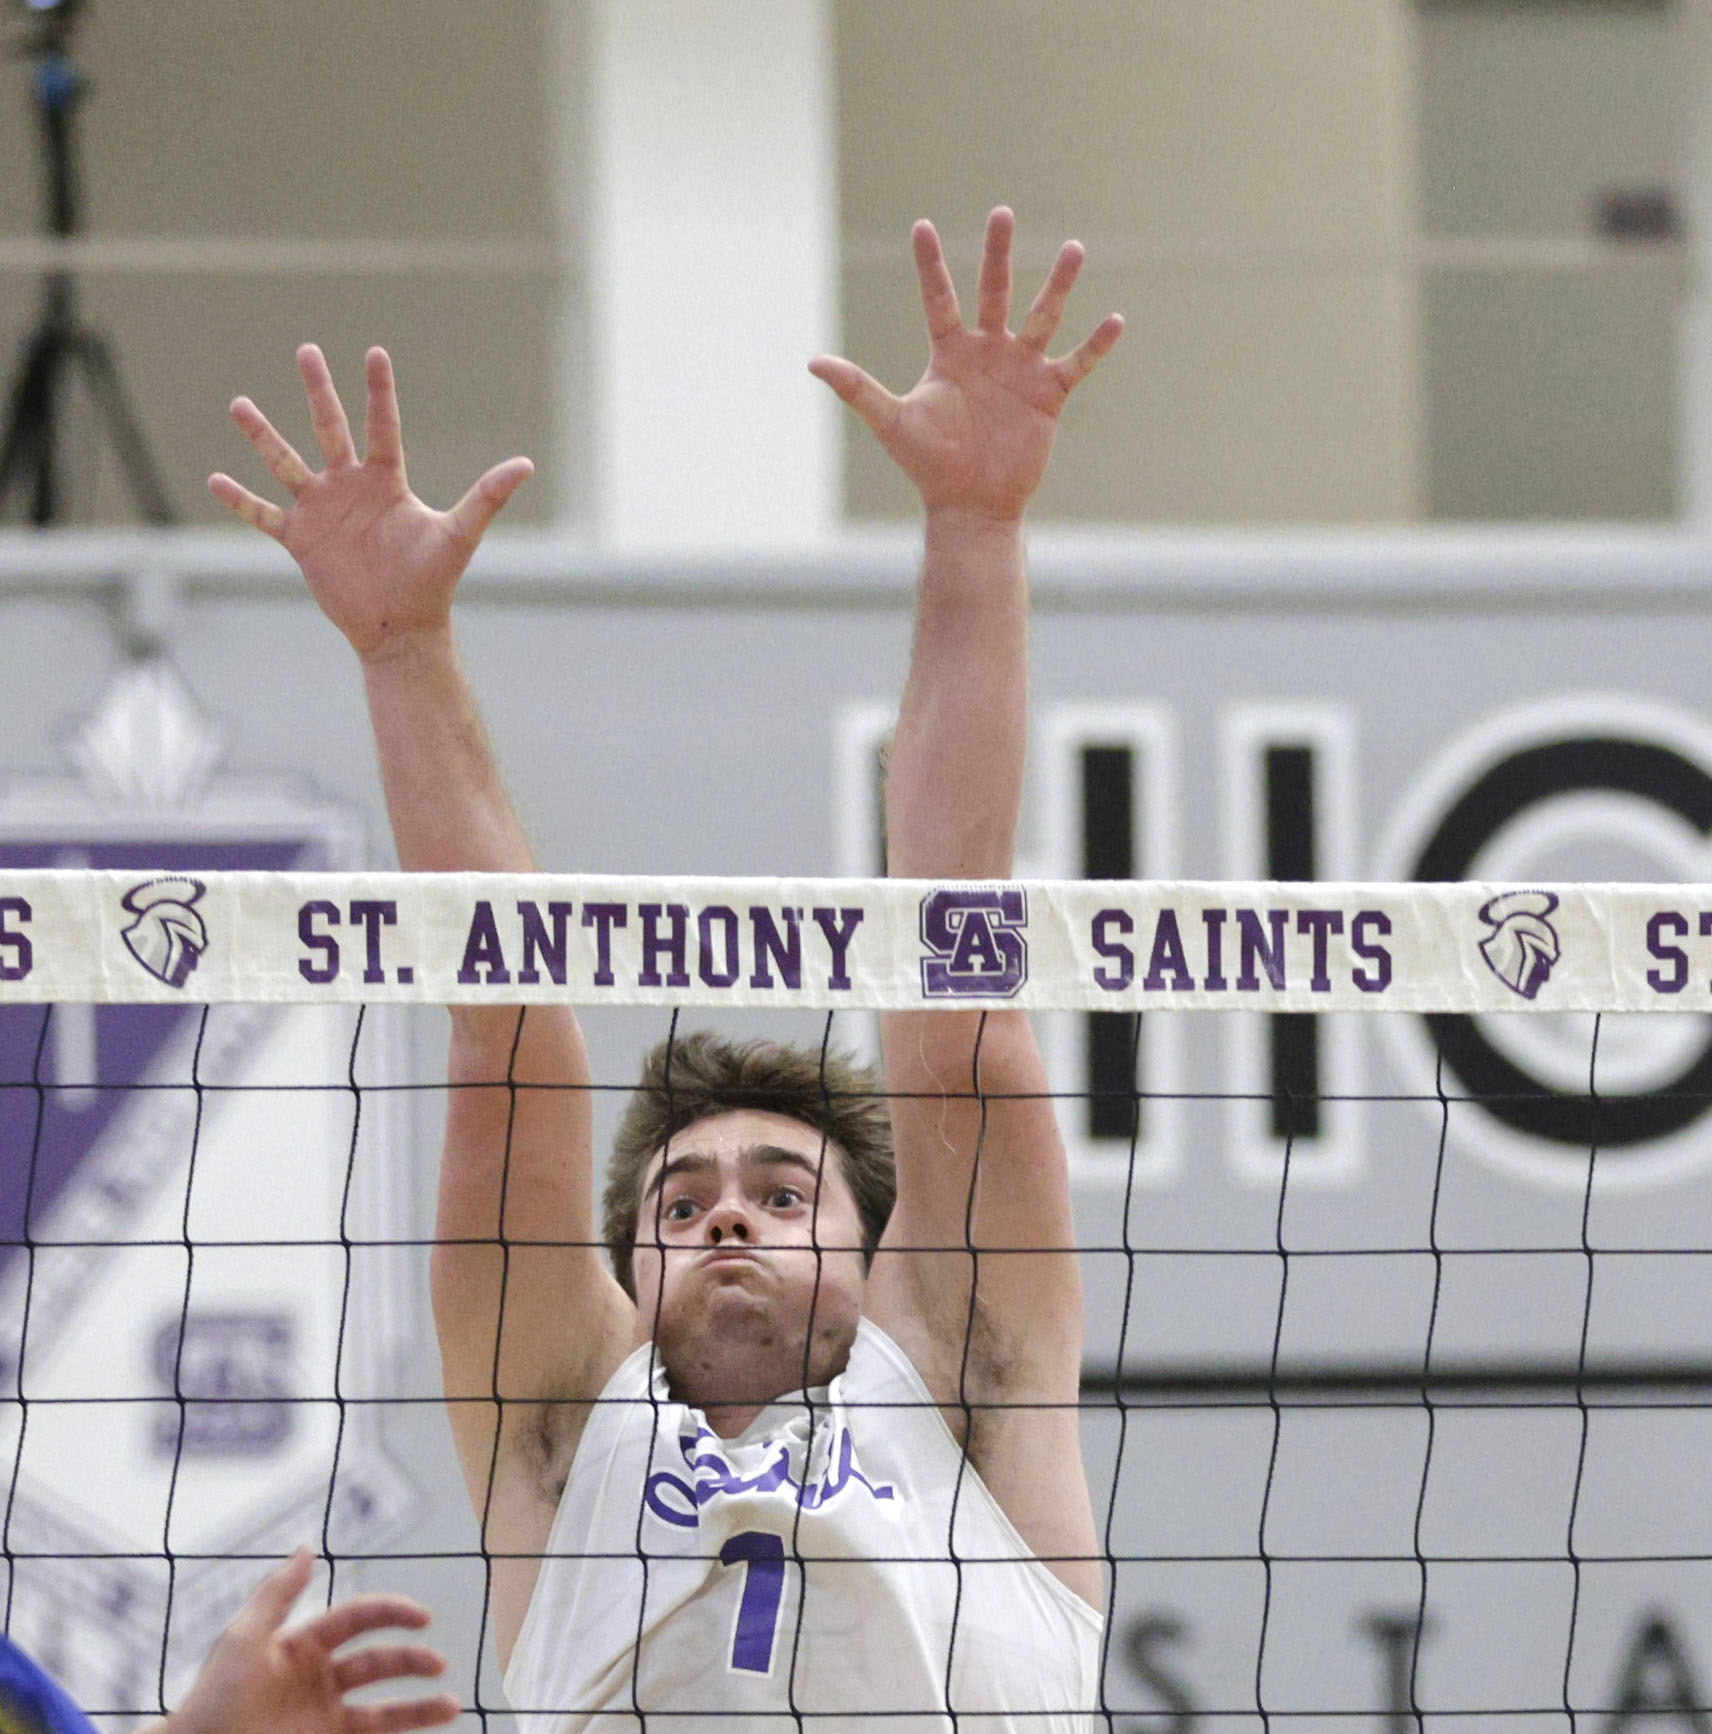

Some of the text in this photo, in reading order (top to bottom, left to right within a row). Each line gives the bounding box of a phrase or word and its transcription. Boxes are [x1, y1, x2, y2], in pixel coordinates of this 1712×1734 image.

[297, 900, 414, 984] ST.
[457, 900, 864, 991] ANTHONY
[1091, 908, 1392, 993] SAINTS
[719, 1530, 786, 1674] 1
